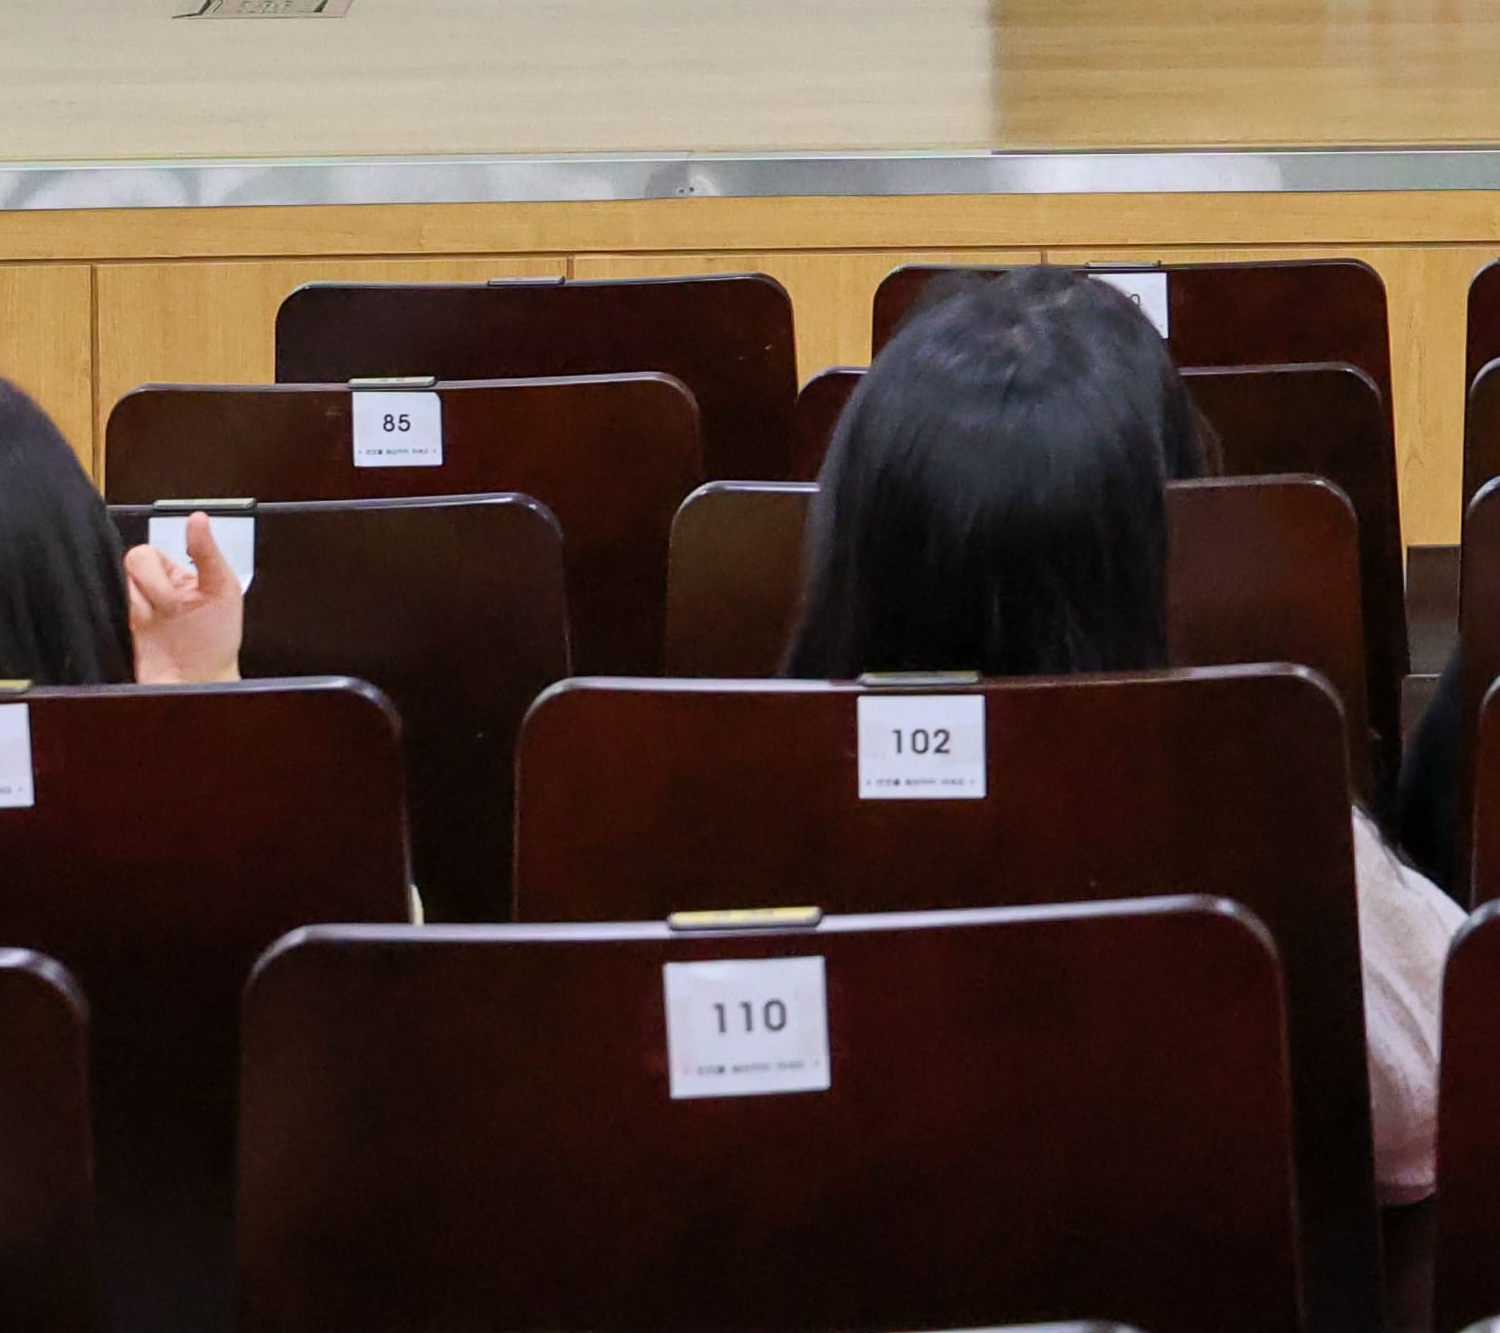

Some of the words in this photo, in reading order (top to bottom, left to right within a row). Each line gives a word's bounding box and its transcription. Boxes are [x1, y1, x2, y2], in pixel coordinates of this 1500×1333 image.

[383, 414, 411, 432] 85
[893, 728, 950, 755] 102
[714, 999, 787, 1034] 110
